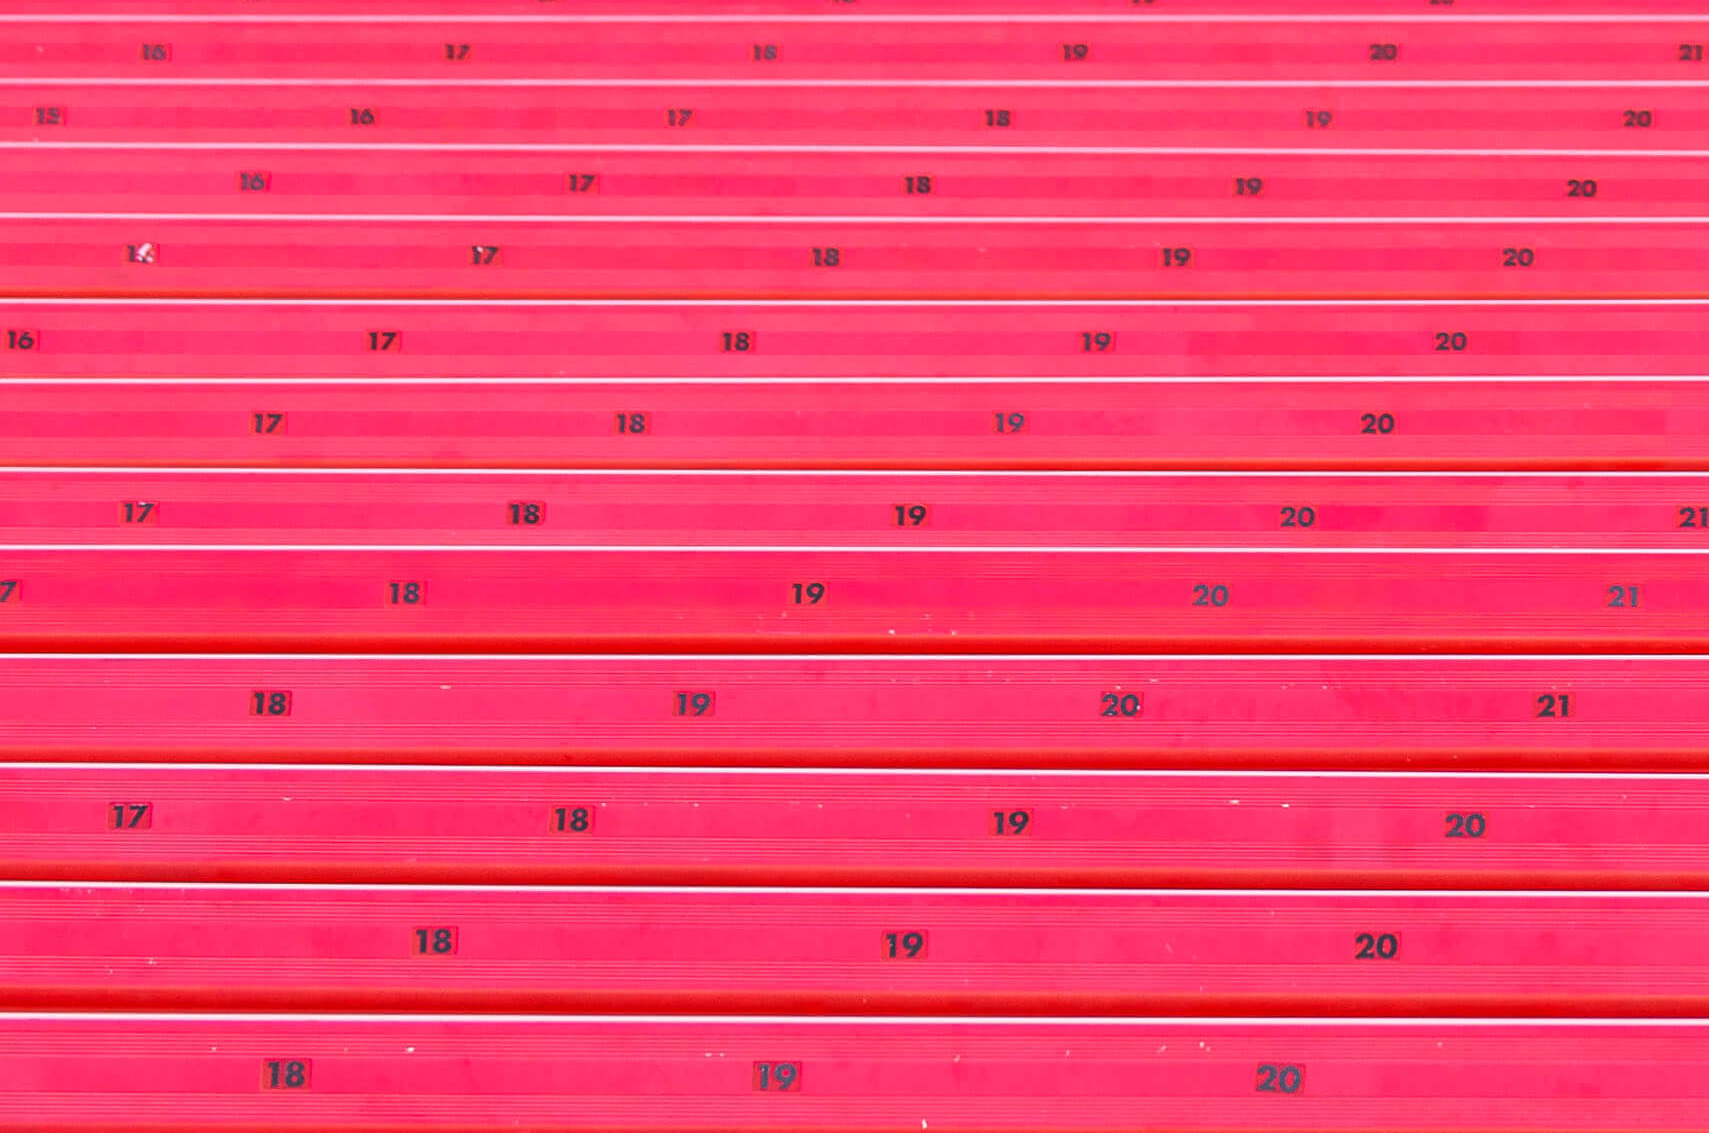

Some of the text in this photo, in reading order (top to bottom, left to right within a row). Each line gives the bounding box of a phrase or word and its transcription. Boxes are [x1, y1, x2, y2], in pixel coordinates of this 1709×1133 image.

[1064, 44, 1088, 59] 19
[1370, 44, 1397, 60] 20
[352, 109, 374, 125] 16
[669, 109, 692, 126] 17
[986, 110, 1010, 127] 18
[1307, 111, 1331, 127] 19
[1624, 110, 1651, 127] 20
[241, 173, 264, 190] 16
[570, 175, 595, 192] 17
[905, 176, 930, 194] 18
[1236, 178, 1262, 195] 19
[1568, 179, 1596, 197] 20
[472, 246, 499, 265] 17
[813, 248, 839, 266] 18
[1163, 248, 1190, 267] 19
[1504, 248, 1533, 267] 20
[8, 331, 33, 349] 16
[369, 332, 396, 350] 17
[723, 332, 749, 351] 18
[1083, 333, 1111, 351] 19
[1436, 332, 1466, 351] 20
[255, 414, 283, 433] 17
[618, 414, 644, 433] 18
[996, 413, 1024, 433] 19
[1362, 413, 1394, 434] 20
[125, 503, 154, 523] 17
[510, 504, 539, 524] 18
[896, 505, 926, 526] 19
[1280, 507, 1314, 527] 20
[1680, 507, 1708, 527] 21
[390, 582, 419, 604] 18
[793, 583, 824, 604] 19
[1192, 584, 1229, 607] 20
[1608, 585, 1638, 607] 21
[254, 692, 286, 715] 18
[678, 693, 710, 715] 19
[1101, 693, 1139, 717] 20
[1538, 694, 1568, 717] 21
[114, 805, 148, 828] 17
[556, 808, 588, 832] 18
[994, 811, 1028, 835] 19
[1446, 813, 1485, 838] 20
[416, 929, 451, 954] 18
[887, 932, 923, 958] 19
[1356, 933, 1397, 959] 20
[269, 1061, 304, 1088] 18
[759, 1064, 796, 1091] 19
[1257, 1064, 1301, 1093] 20
